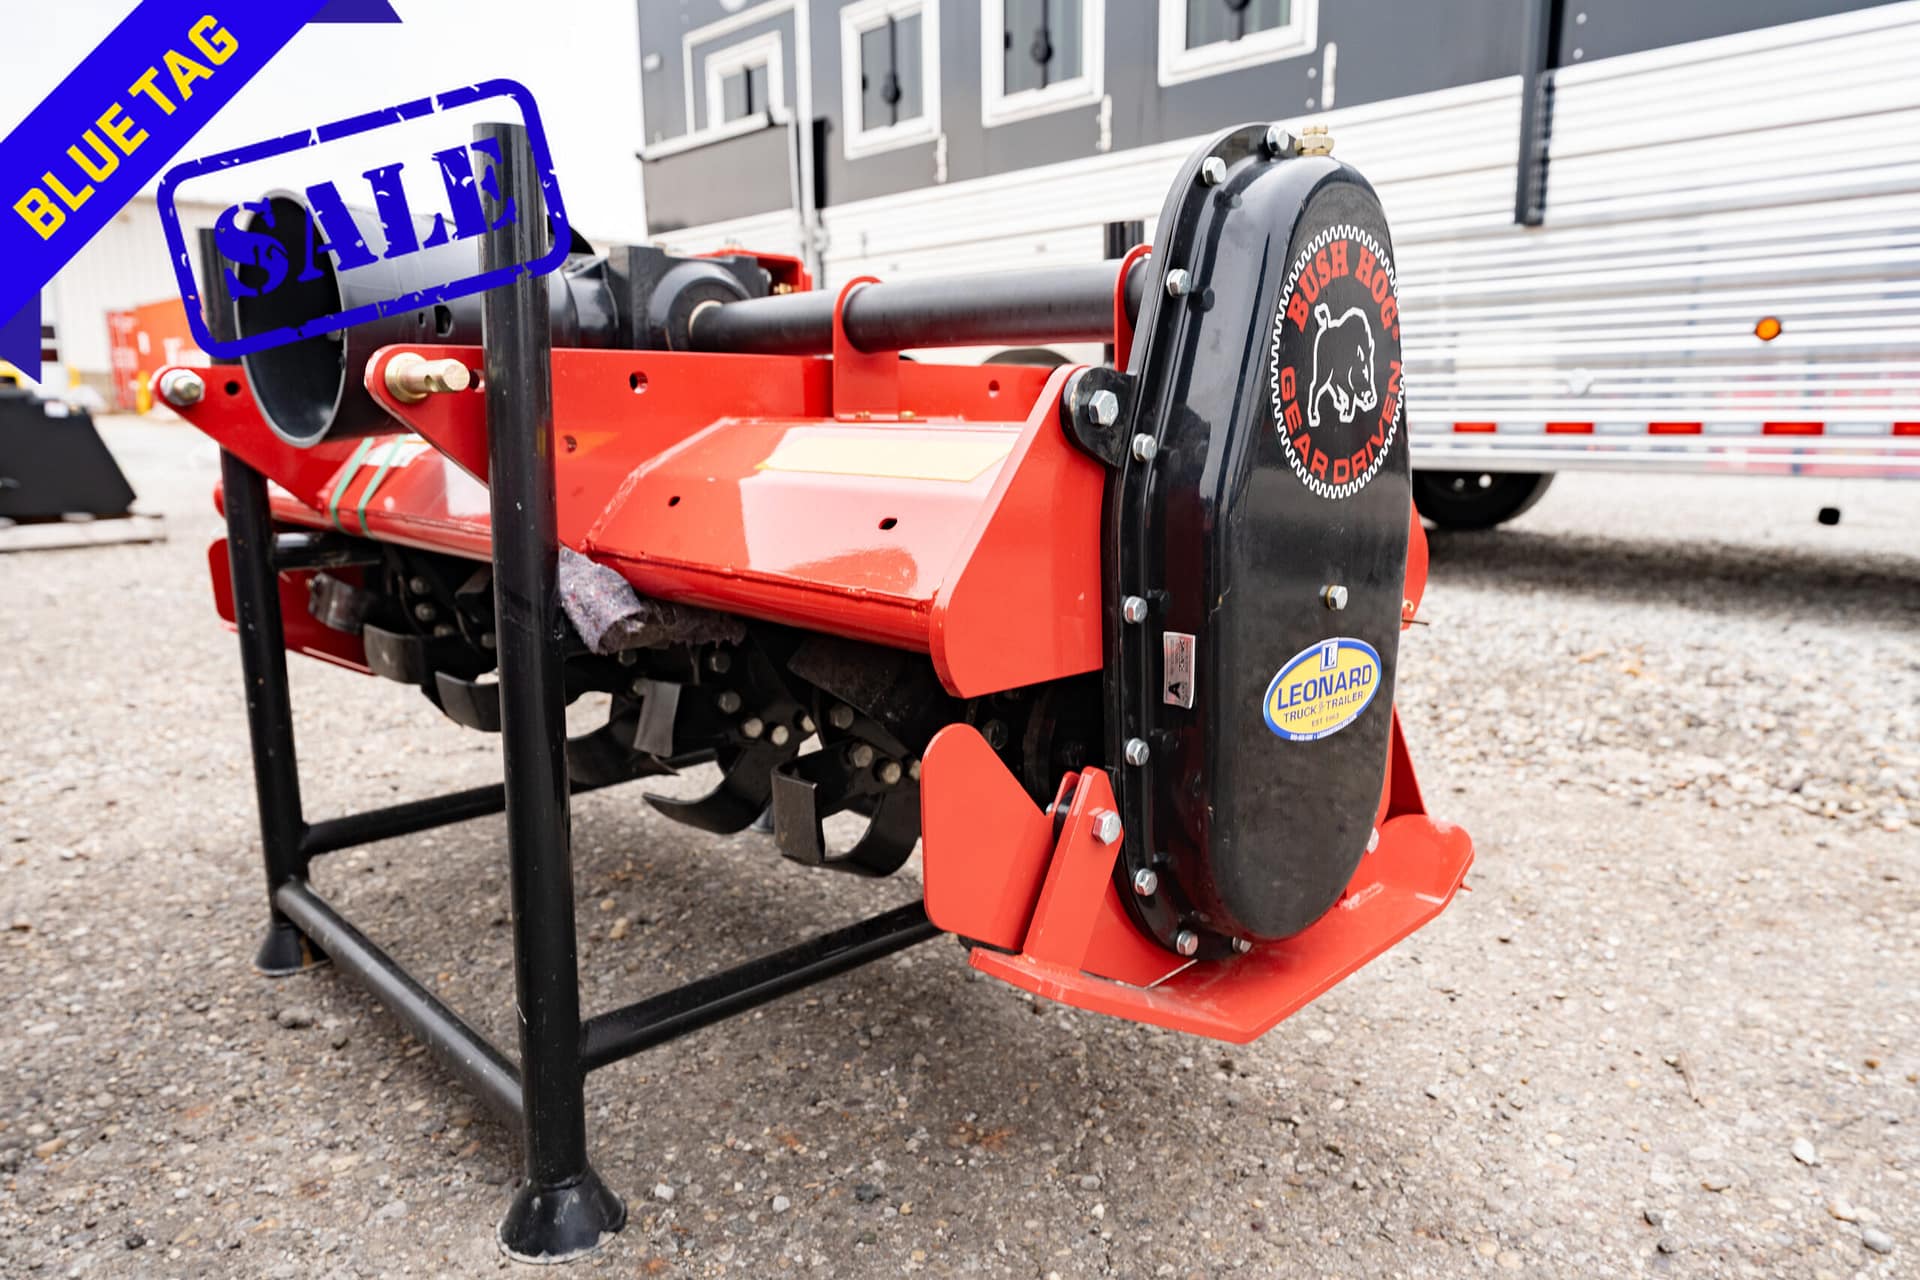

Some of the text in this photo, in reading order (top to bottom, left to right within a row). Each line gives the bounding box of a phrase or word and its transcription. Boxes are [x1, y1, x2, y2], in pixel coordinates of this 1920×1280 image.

[1287, 240, 1349, 332] BUSH
[1281, 360, 1401, 485] GEAR DRIVEN
[1278, 664, 1372, 710] LEONARD
[1284, 703, 1317, 723] TRUCK
[1326, 691, 1364, 711] TRAILER
